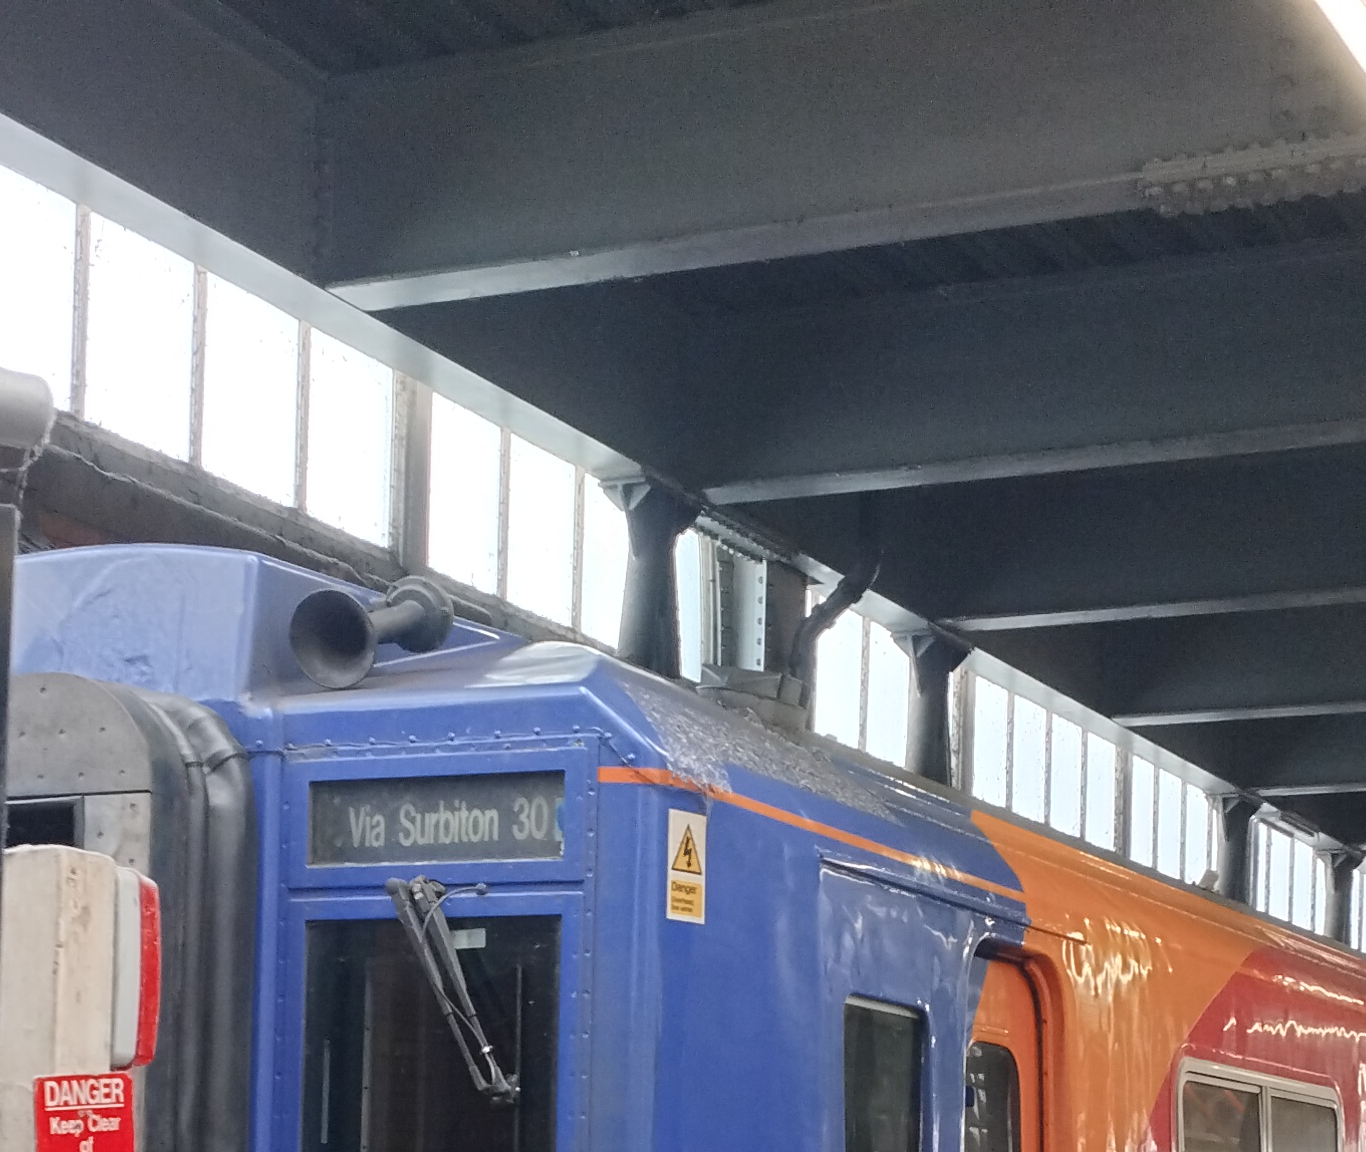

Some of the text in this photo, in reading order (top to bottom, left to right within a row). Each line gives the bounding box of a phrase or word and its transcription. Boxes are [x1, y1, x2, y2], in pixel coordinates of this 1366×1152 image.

[349, 803, 385, 849] Via
[398, 799, 499, 848] Surbiton
[512, 794, 549, 841] 30
[43, 1077, 125, 1107] DANGER
[49, 1113, 121, 1138] Keep Clear
